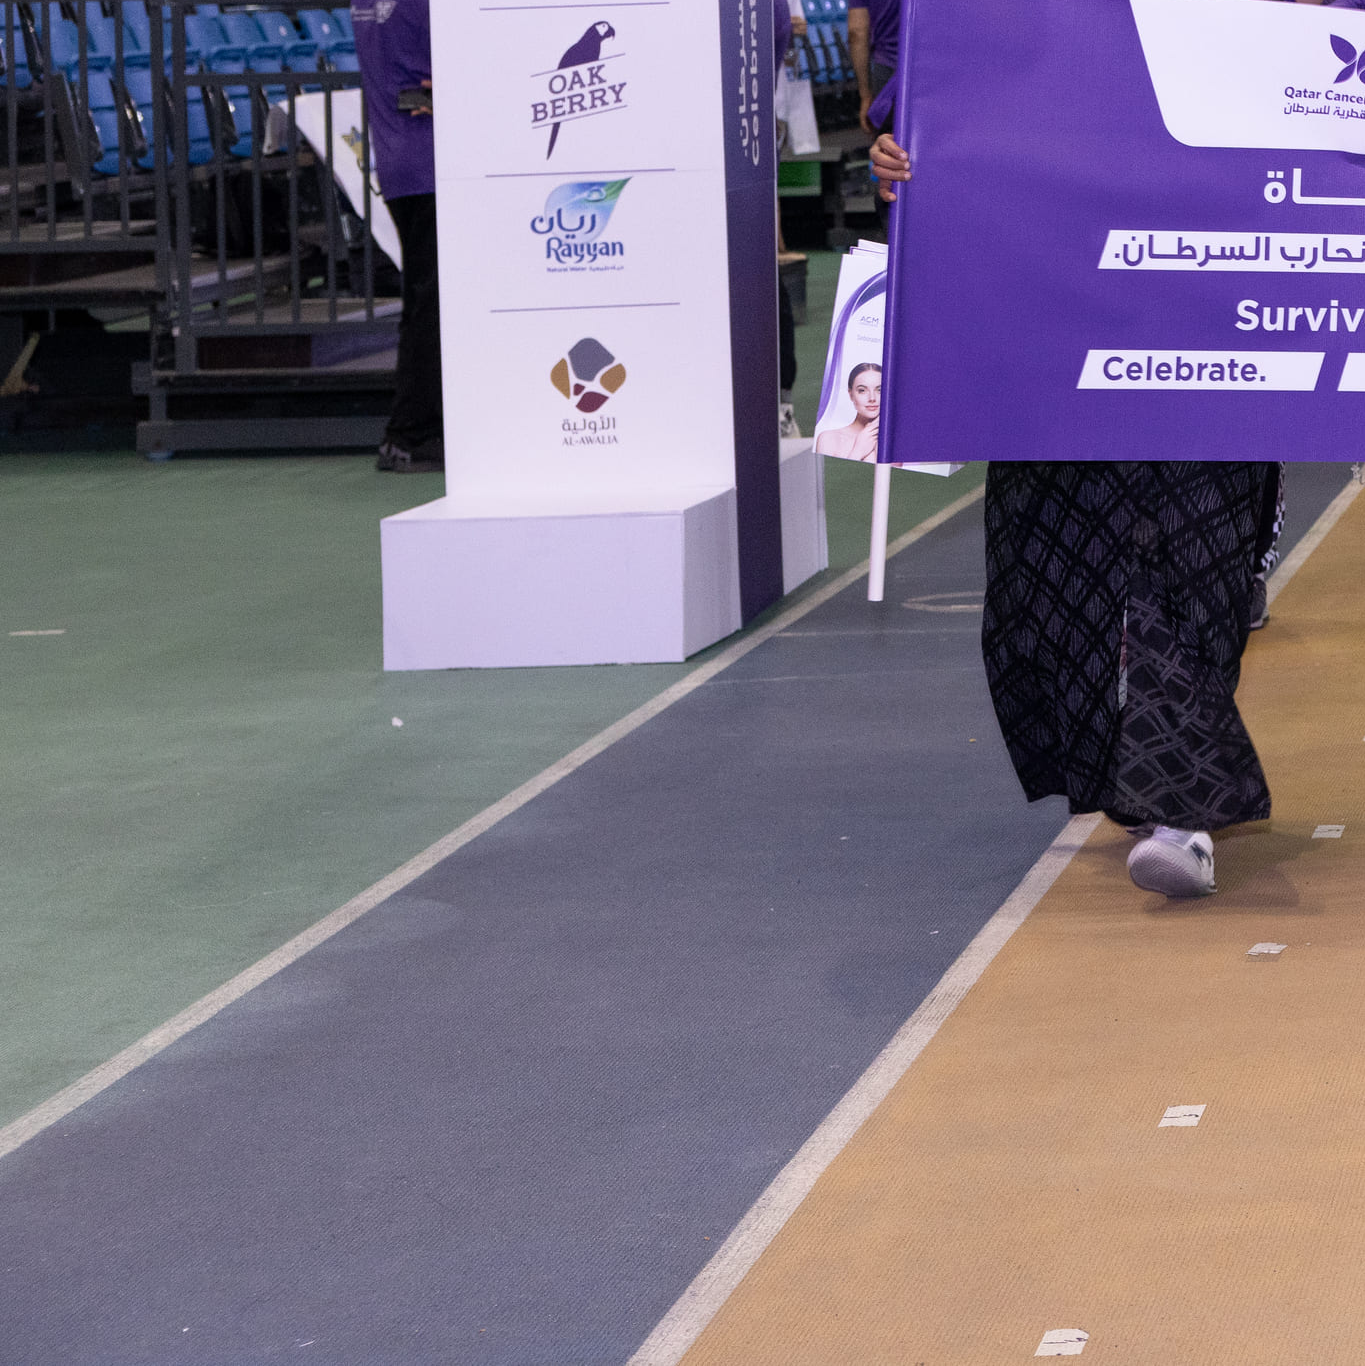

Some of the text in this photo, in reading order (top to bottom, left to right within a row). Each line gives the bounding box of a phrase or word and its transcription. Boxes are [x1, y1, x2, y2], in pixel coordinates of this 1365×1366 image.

[549, 65, 606, 98] OAK
[1284, 87, 1321, 99] Qatar
[531, 77, 626, 122] BERRY
[1284, 103, 1330, 115] للسرطان
[547, 234, 623, 263] Rayyan
[1103, 356, 1265, 382] Celebrate.
